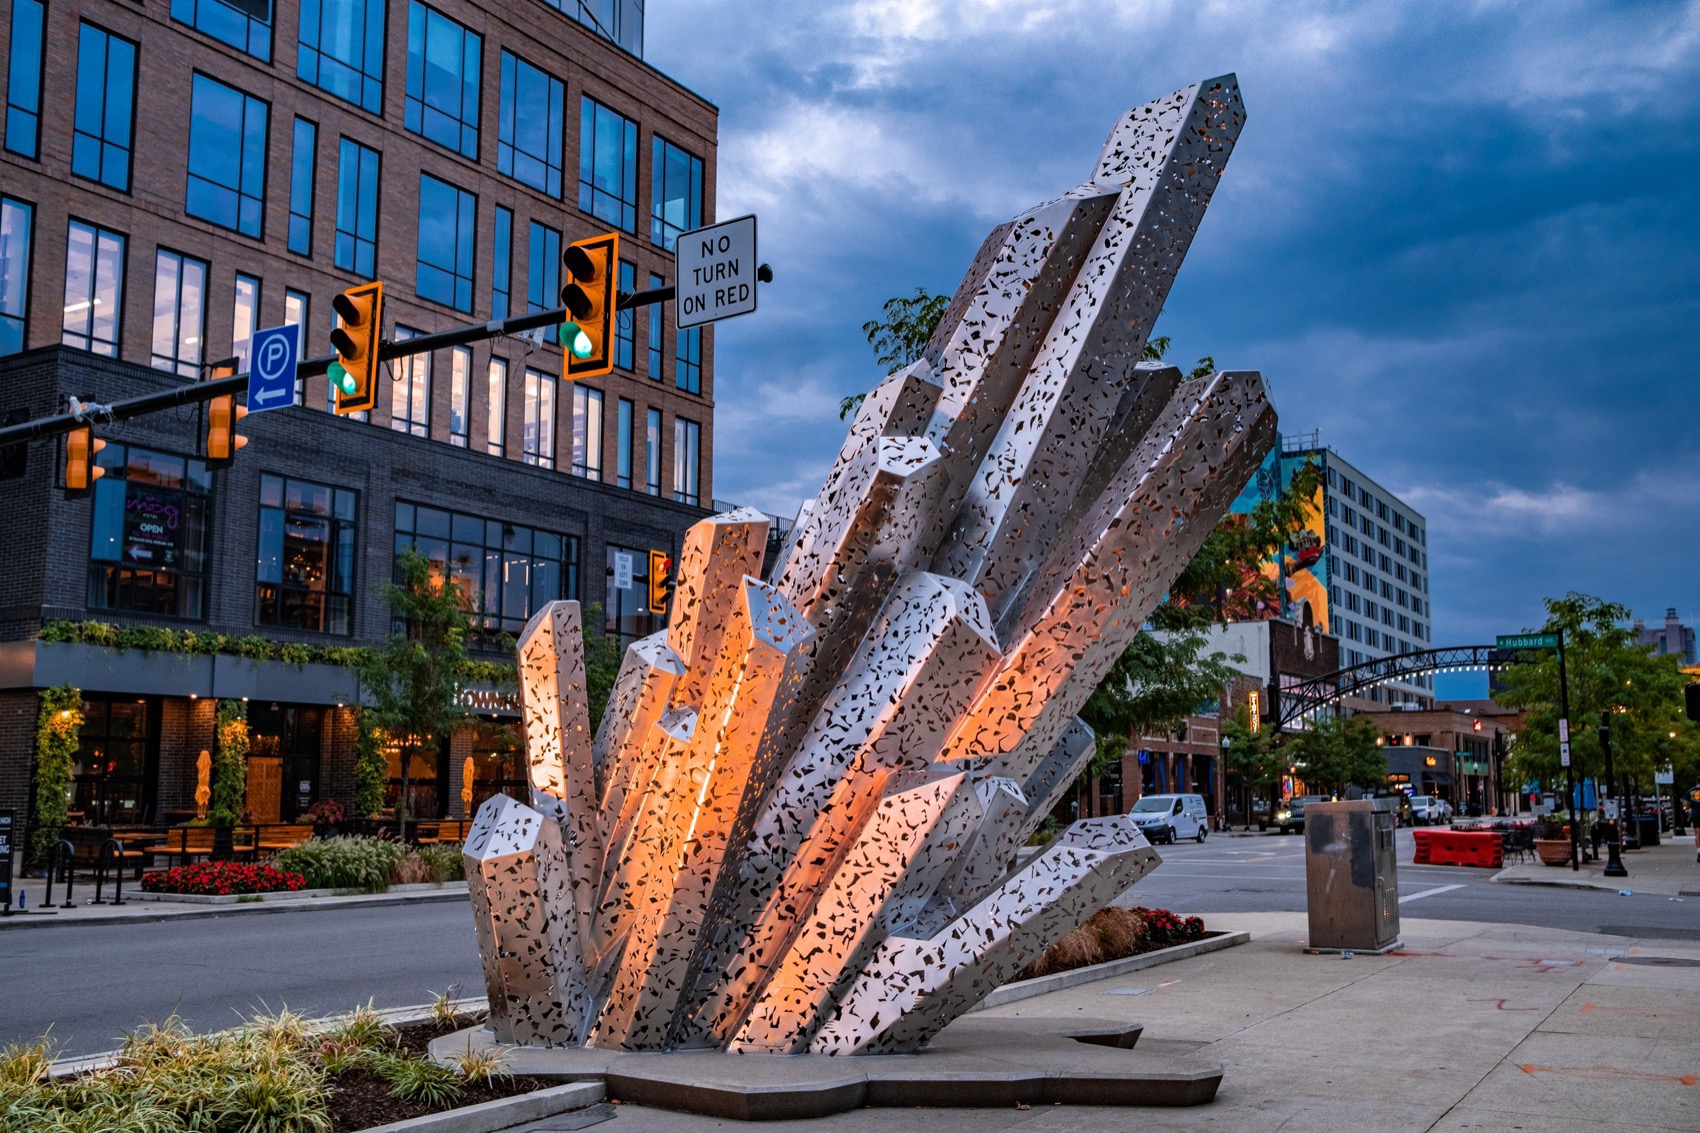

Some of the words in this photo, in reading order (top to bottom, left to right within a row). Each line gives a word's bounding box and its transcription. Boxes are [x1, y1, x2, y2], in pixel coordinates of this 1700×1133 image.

[701, 235, 731, 258] NO
[693, 258, 739, 286] TURN
[683, 293, 705, 315] ON
[715, 283, 750, 308] RED
[266, 342, 284, 372] P
[139, 523, 163, 534] OPEN
[1505, 637, 1543, 647] Hubbard
